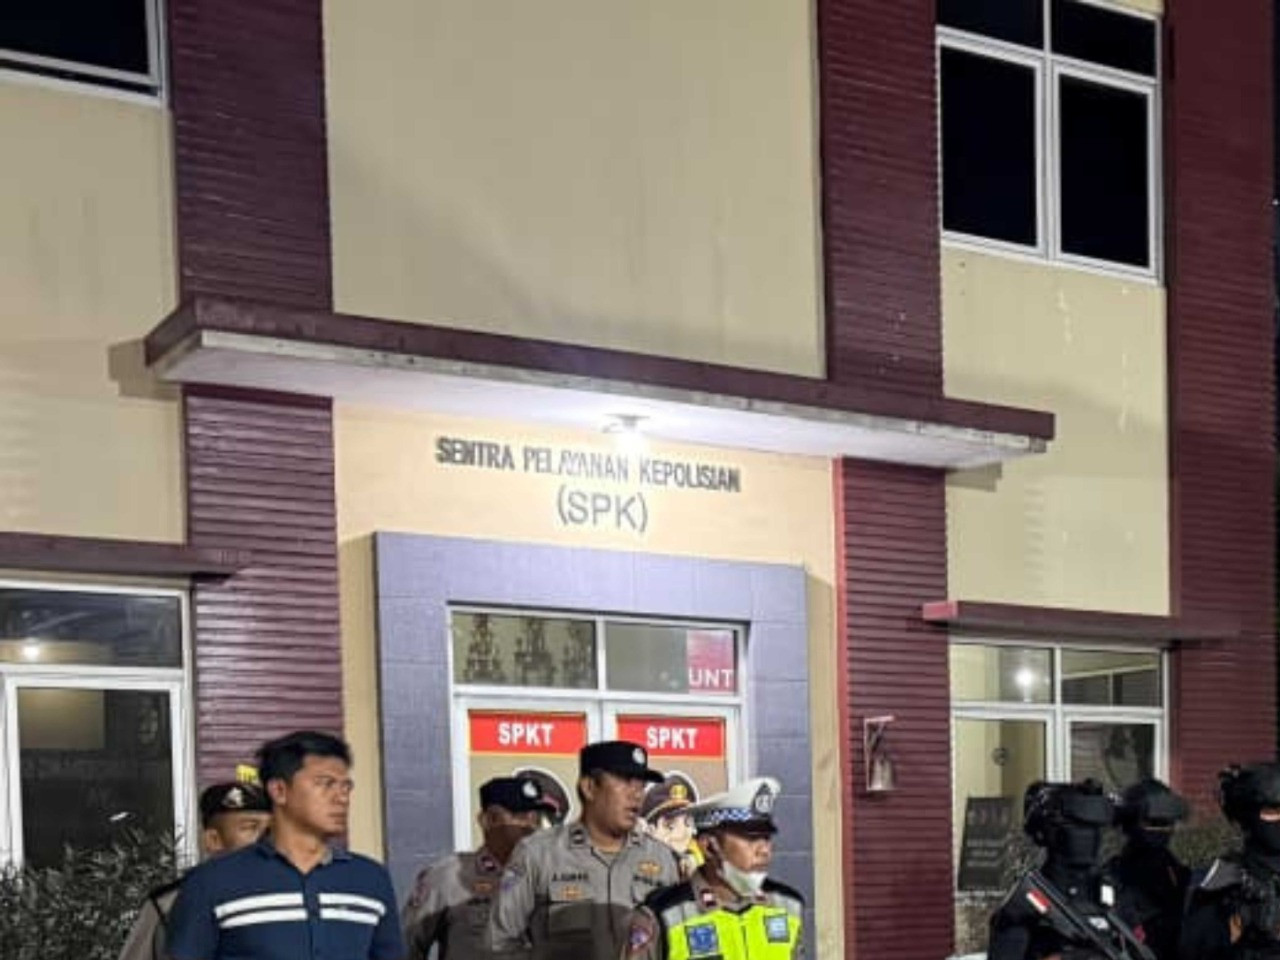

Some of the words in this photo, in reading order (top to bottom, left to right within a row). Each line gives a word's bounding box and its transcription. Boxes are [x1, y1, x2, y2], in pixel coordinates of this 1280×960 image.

[435, 436, 516, 471] SENTRA
[523, 445, 630, 483] PELAYANAN
[639, 457, 742, 493] KEPOLISIAN
[557, 483, 649, 534] (SPK)
[497, 721, 555, 747] SPKT
[646, 725, 698, 750] SPKT
